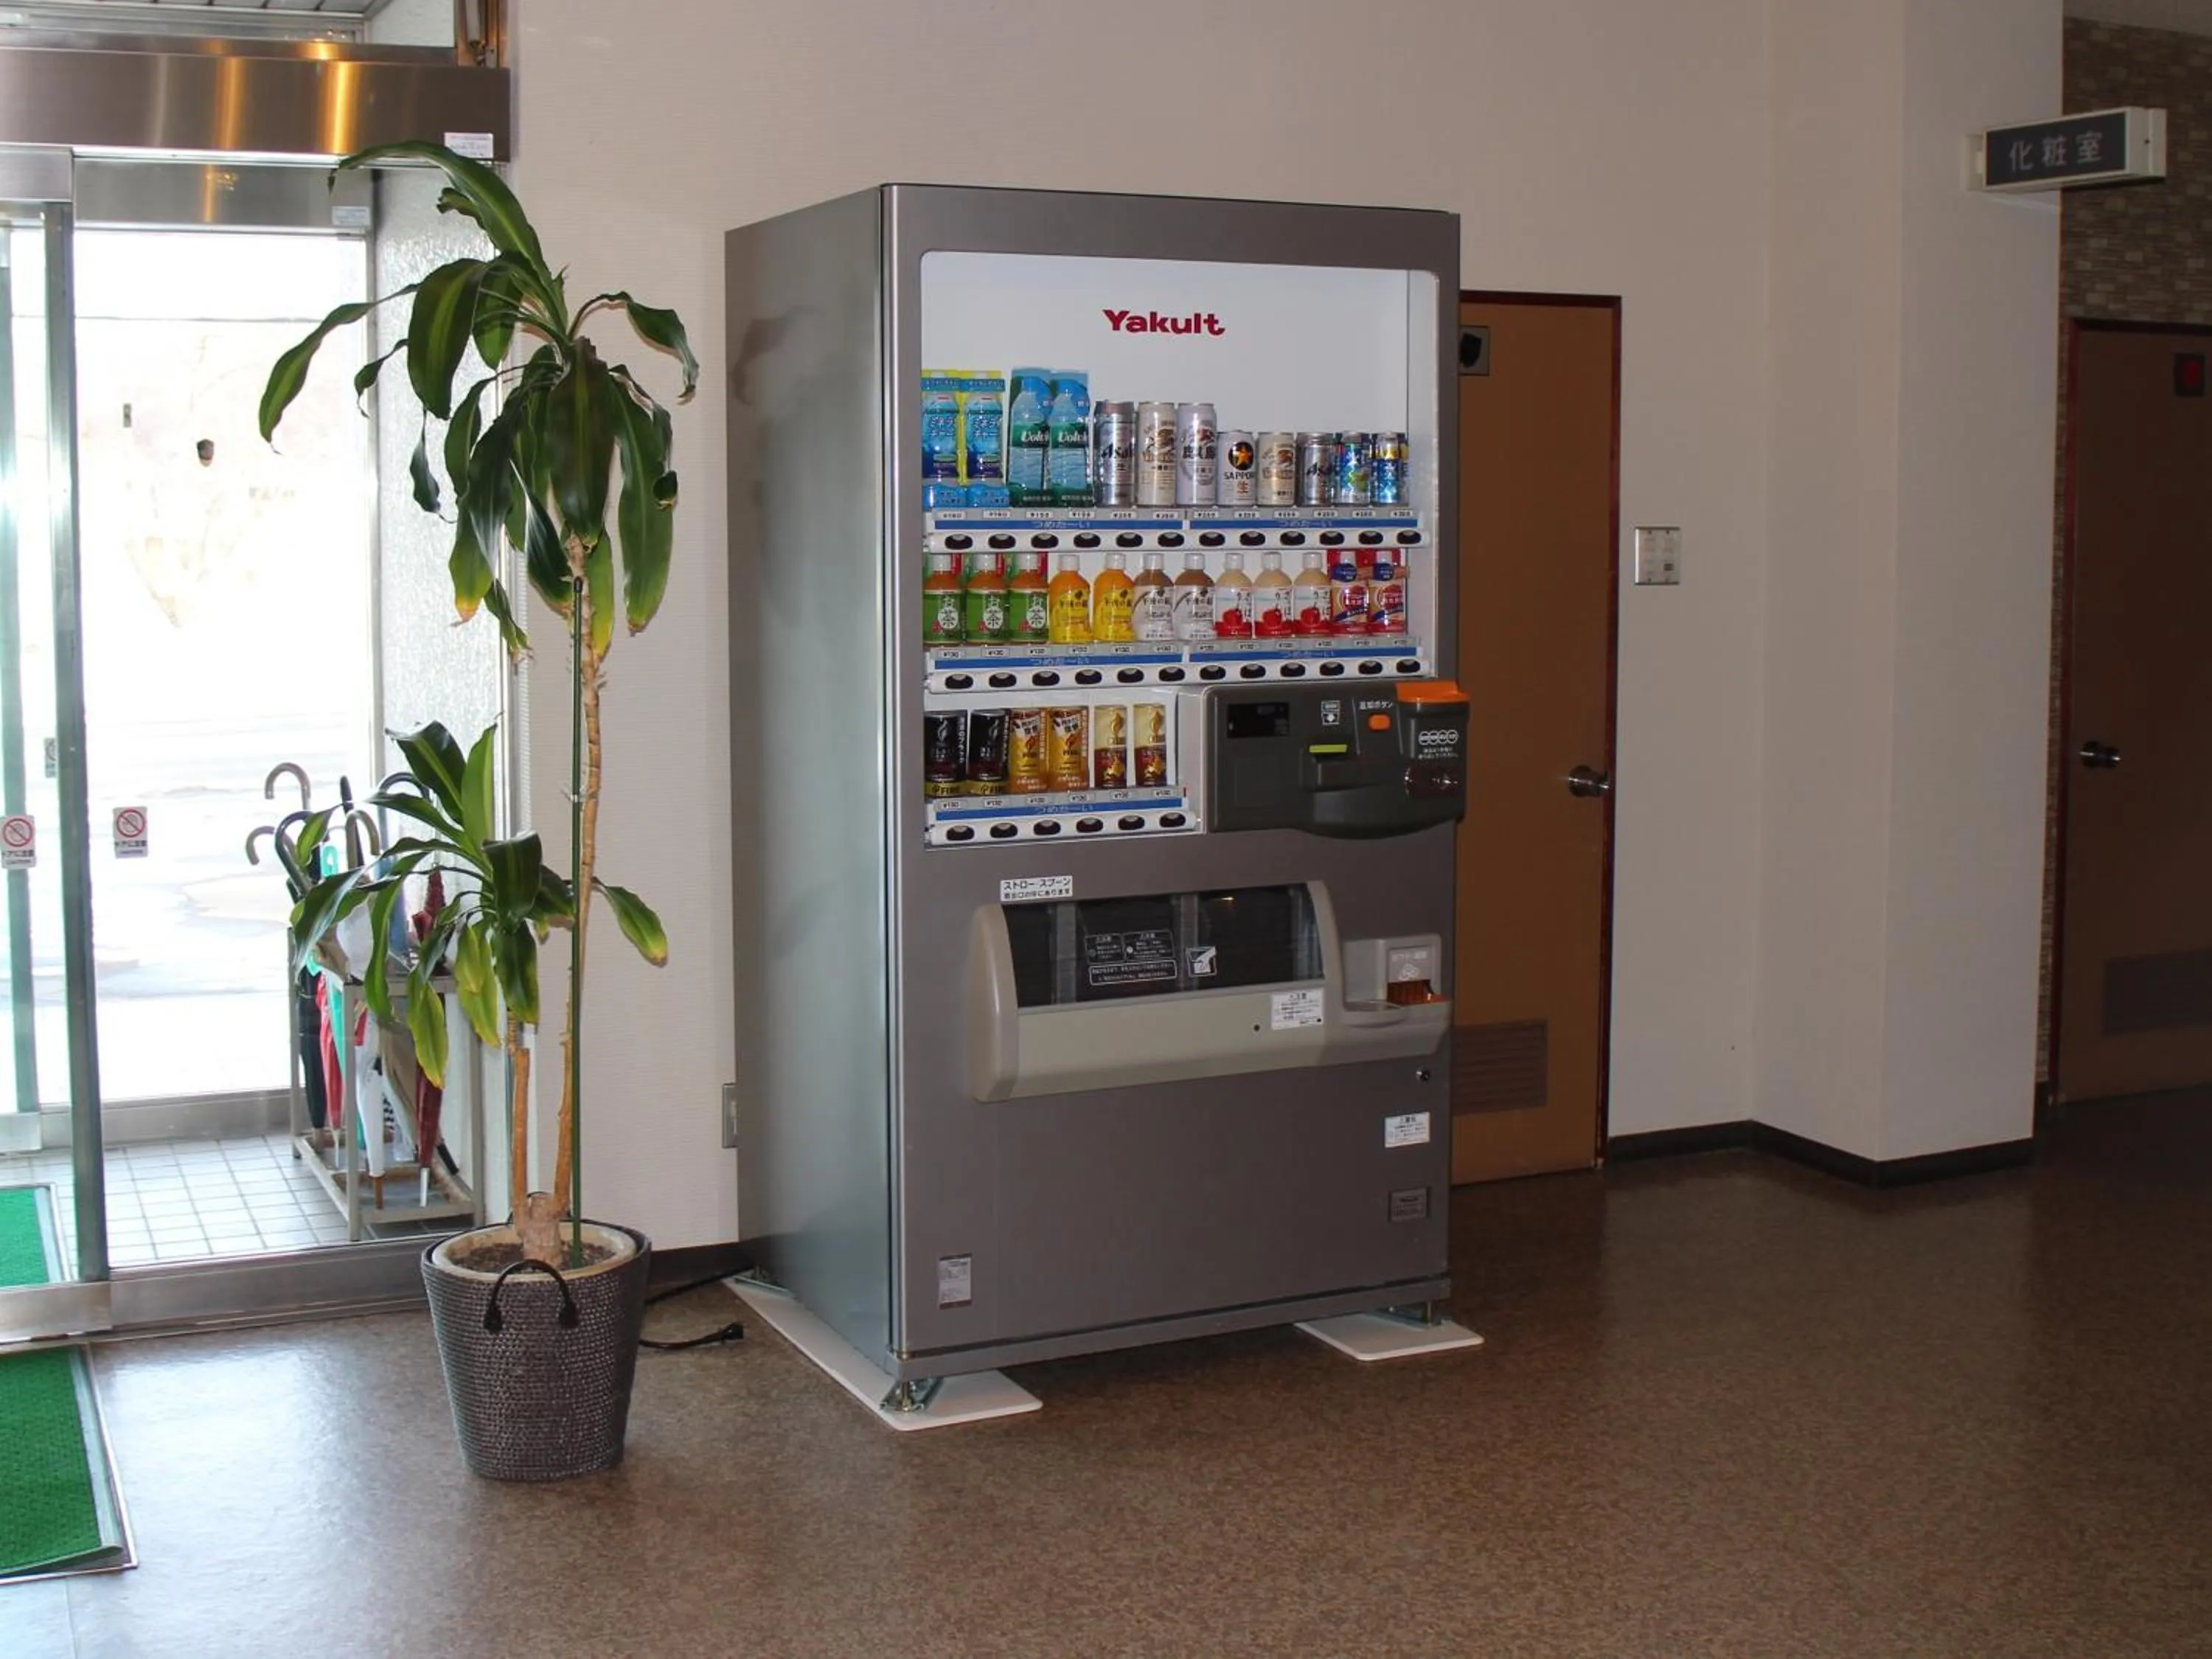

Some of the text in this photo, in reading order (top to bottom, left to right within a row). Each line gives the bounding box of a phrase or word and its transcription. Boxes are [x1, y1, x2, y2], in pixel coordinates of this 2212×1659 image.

[2008, 129, 2103, 173] 化粧室
[1102, 309, 1226, 336] Yakult
[1224, 471, 1253, 480] SAPPO
[1004, 877, 1071, 890] ストロー スプーン
